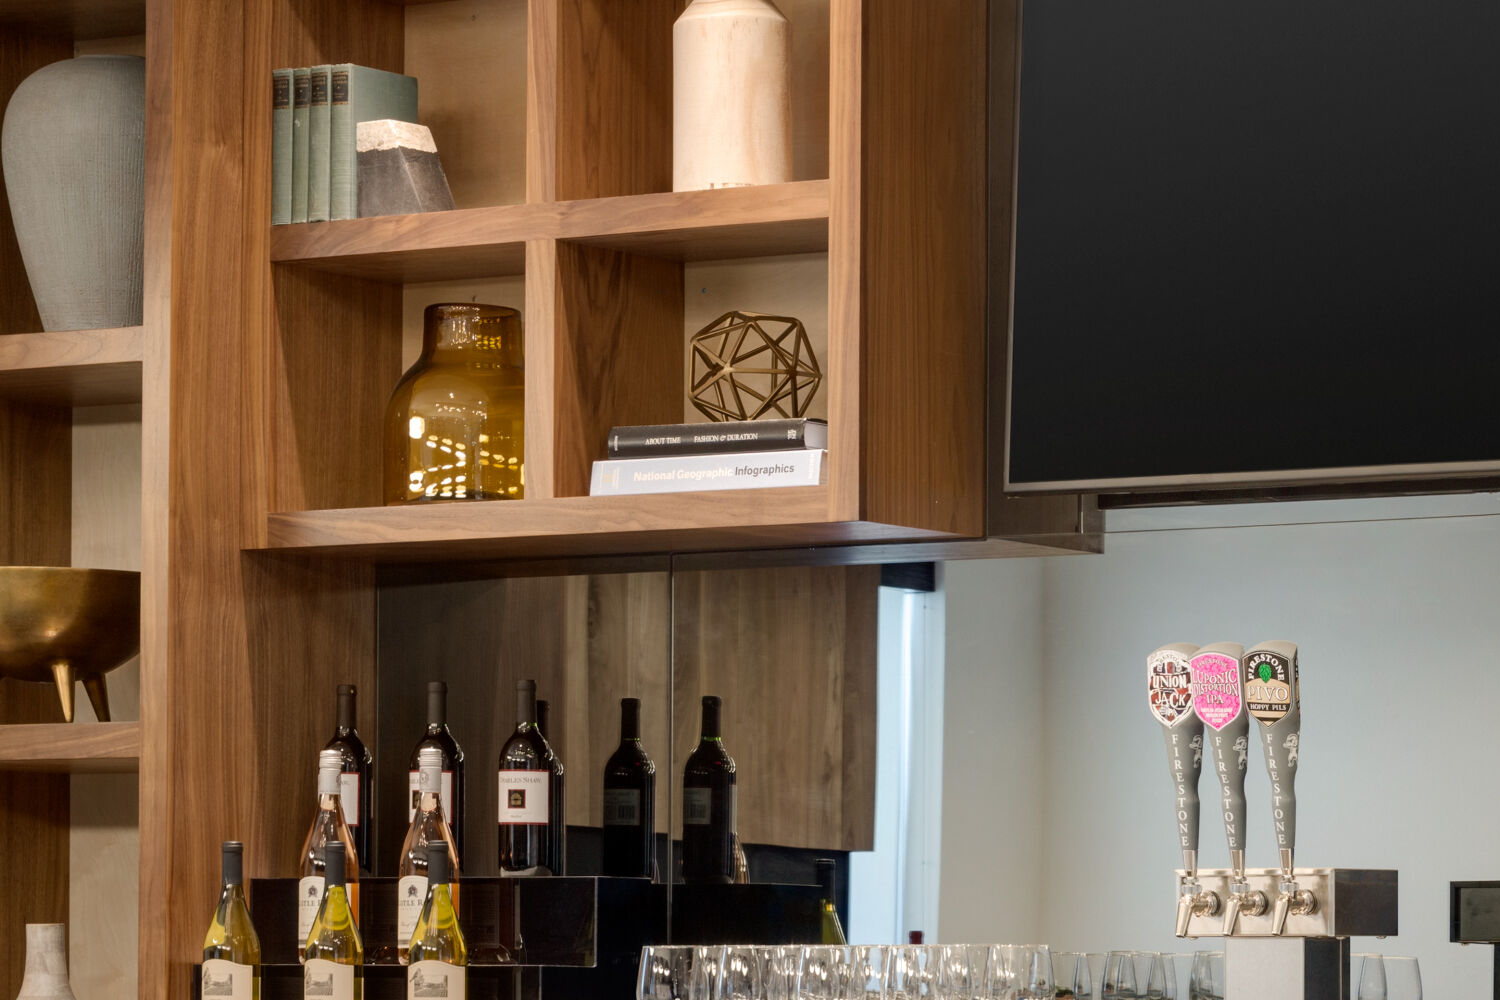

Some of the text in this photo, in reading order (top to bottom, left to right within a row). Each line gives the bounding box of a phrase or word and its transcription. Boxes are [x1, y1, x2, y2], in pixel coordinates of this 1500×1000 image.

[694, 435, 719, 443] FASHION
[727, 433, 758, 441] DURATION
[633, 469, 675, 481] National
[677, 467, 733, 481] Geographic
[735, 464, 795, 477] Infographics
[1248, 654, 1285, 681] FIRESTONE
[1152, 675, 1187, 689] UNION
[1191, 668, 1237, 684] LUPONIC
[1155, 688, 1187, 709] JACK
[1191, 683, 1239, 698] DISTORTION
[1247, 686, 1288, 702] PIVO
[1206, 694, 1224, 704] IPA
[1250, 703, 1287, 711] HOPPY PILS
[1172, 734, 1189, 847] FIRESTONE
[1215, 736, 1236, 847] FIRESTONE
[1266, 733, 1286, 845] FIRESTONE
